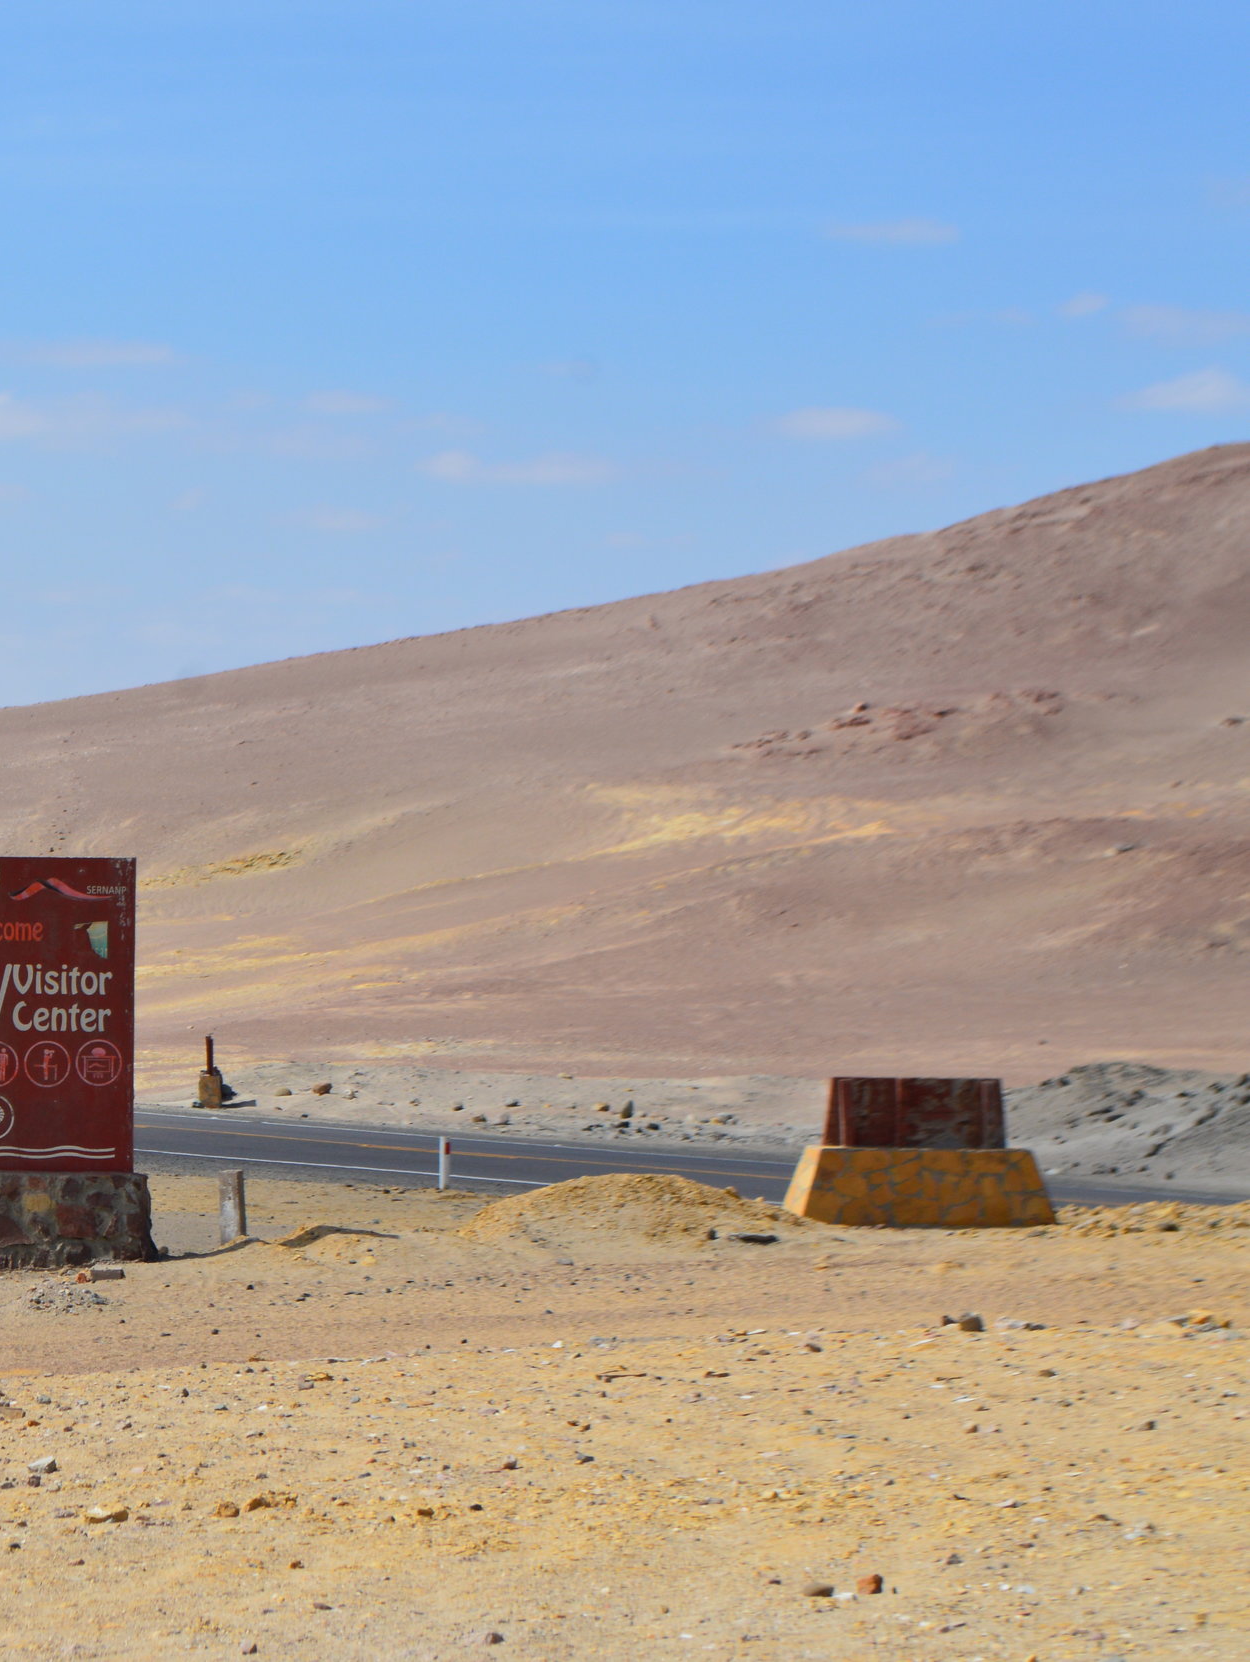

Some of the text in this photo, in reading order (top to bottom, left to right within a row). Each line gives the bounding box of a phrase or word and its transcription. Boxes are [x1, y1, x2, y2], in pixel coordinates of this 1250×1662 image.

[86, 885, 127, 895] SERNANP
[11, 964, 113, 996] Visitor
[12, 1001, 112, 1032] Center
